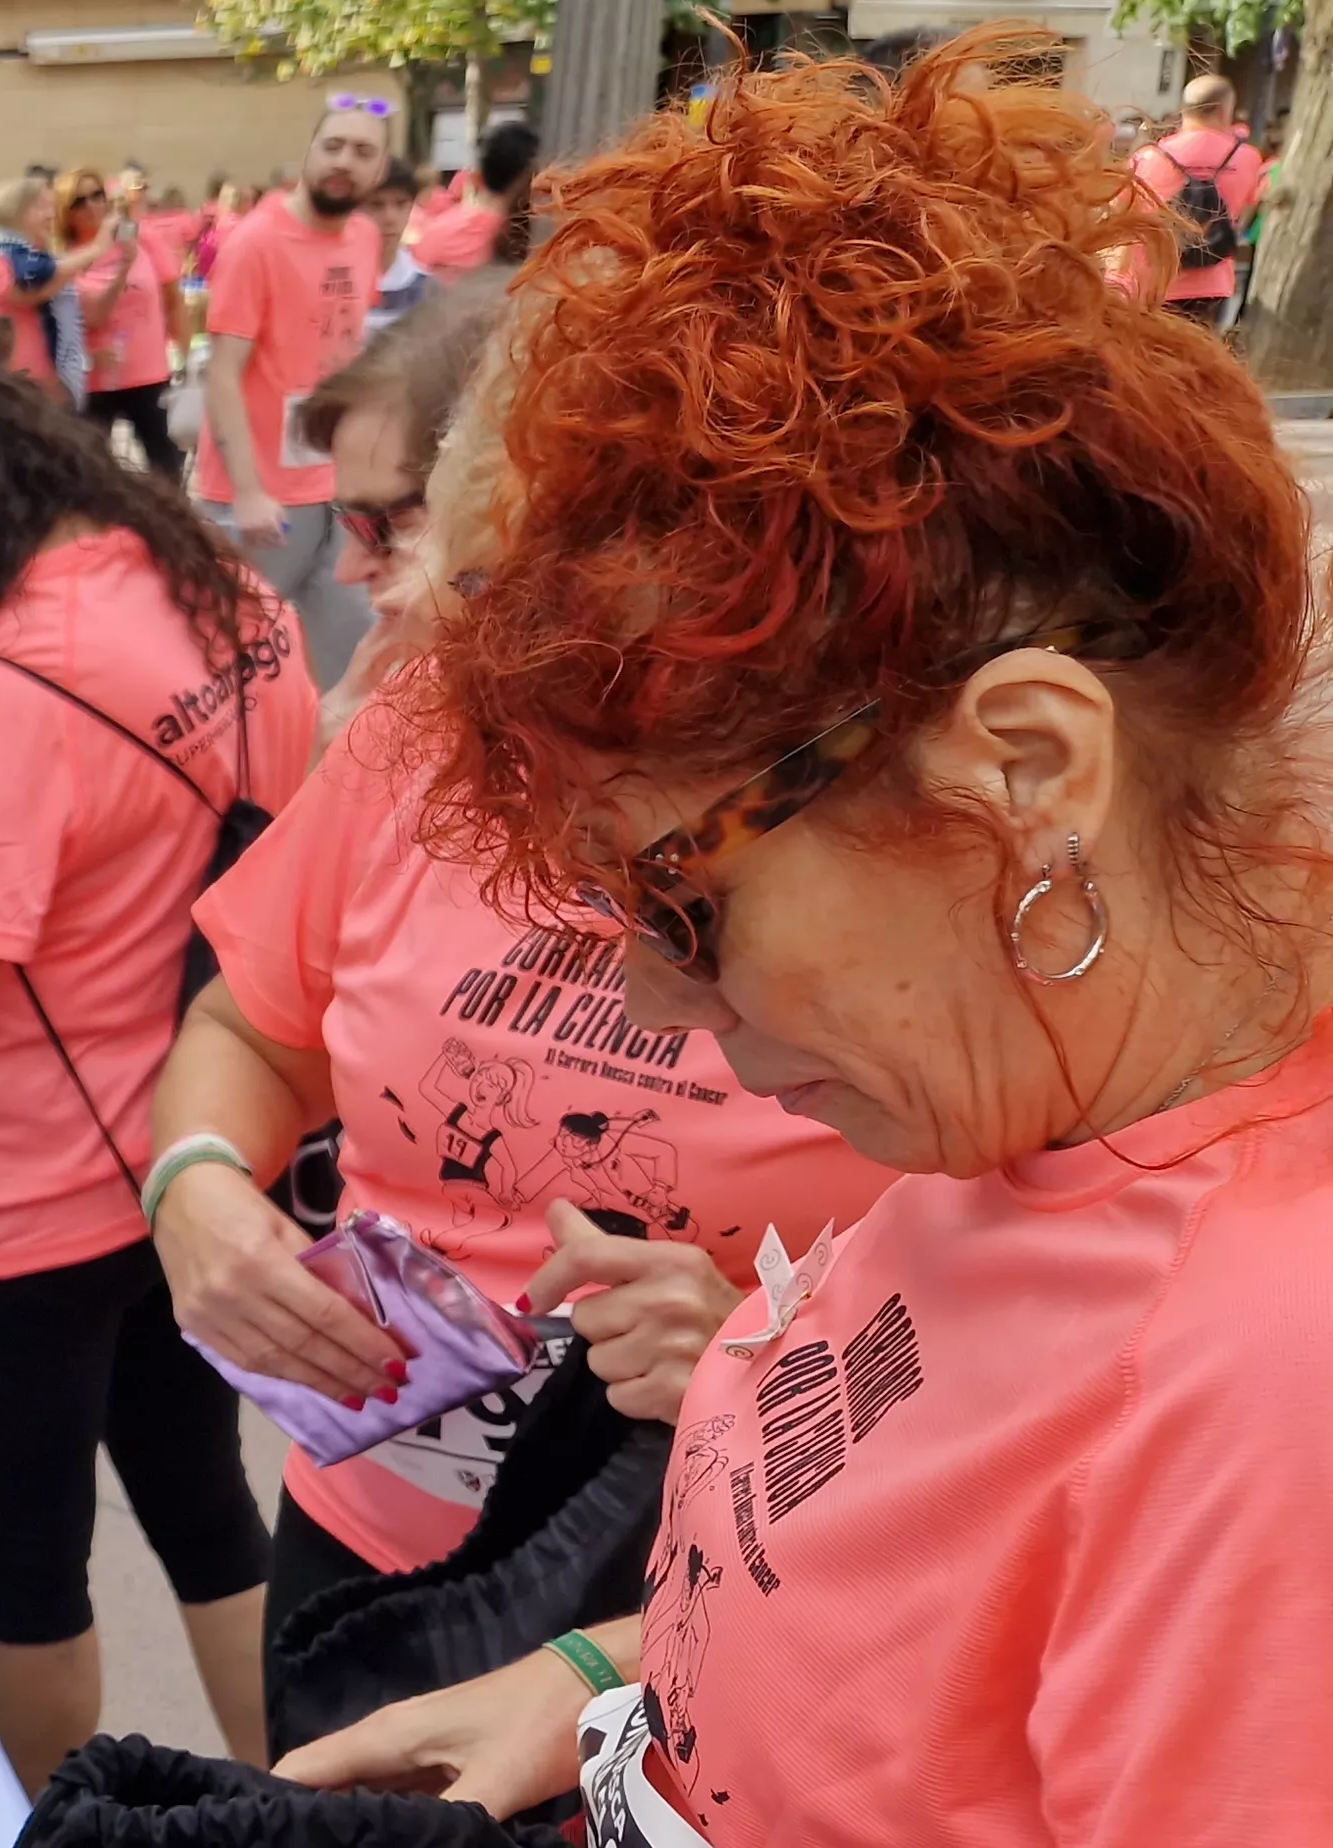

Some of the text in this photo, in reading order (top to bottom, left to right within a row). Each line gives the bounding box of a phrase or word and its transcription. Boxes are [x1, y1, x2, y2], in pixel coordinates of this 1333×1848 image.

[439, 967, 518, 1027] POR
[508, 980, 562, 1037] LA
[445, 1132, 467, 1161] 19
[756, 1339, 847, 1526] POR LA CIENCIA
